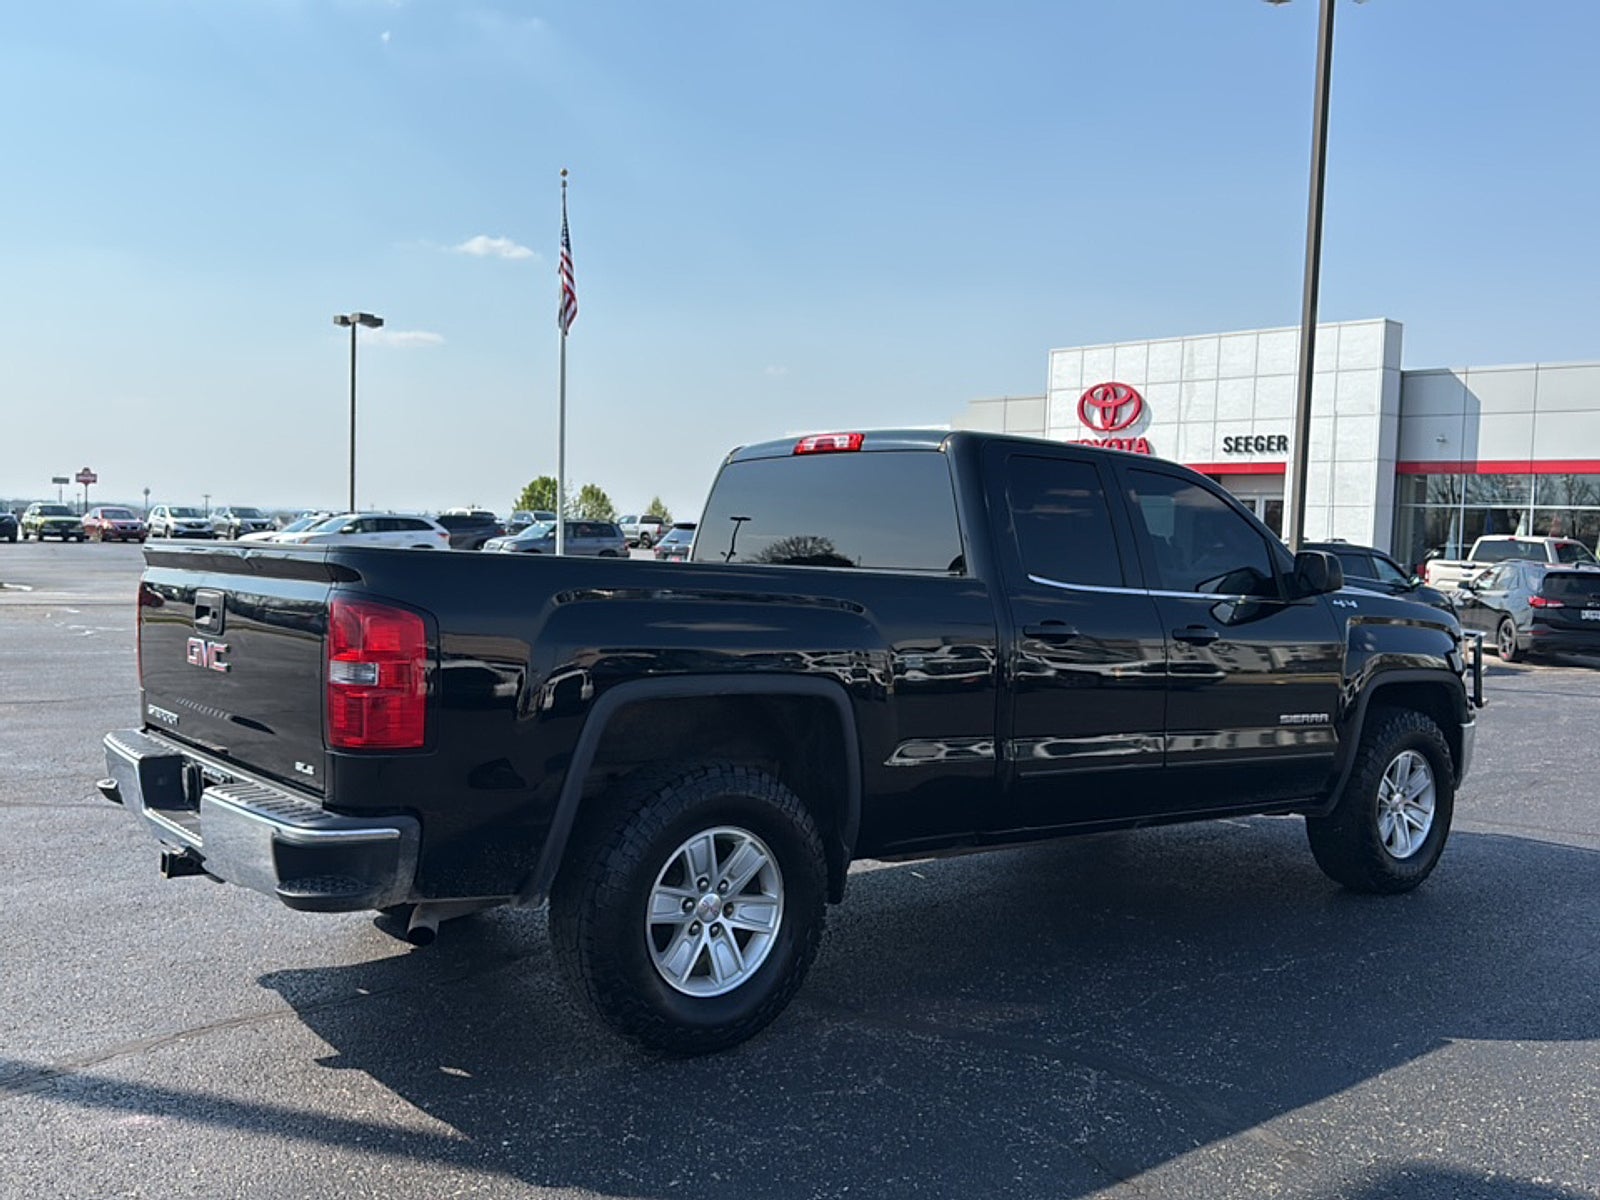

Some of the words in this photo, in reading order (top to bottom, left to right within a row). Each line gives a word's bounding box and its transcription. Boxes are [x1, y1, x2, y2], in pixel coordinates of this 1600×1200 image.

[1066, 437, 1151, 455] YOTA
[1223, 435, 1288, 453] SEEGER
[187, 636, 230, 672] GMC
[1279, 713, 1329, 725] SIERRA
